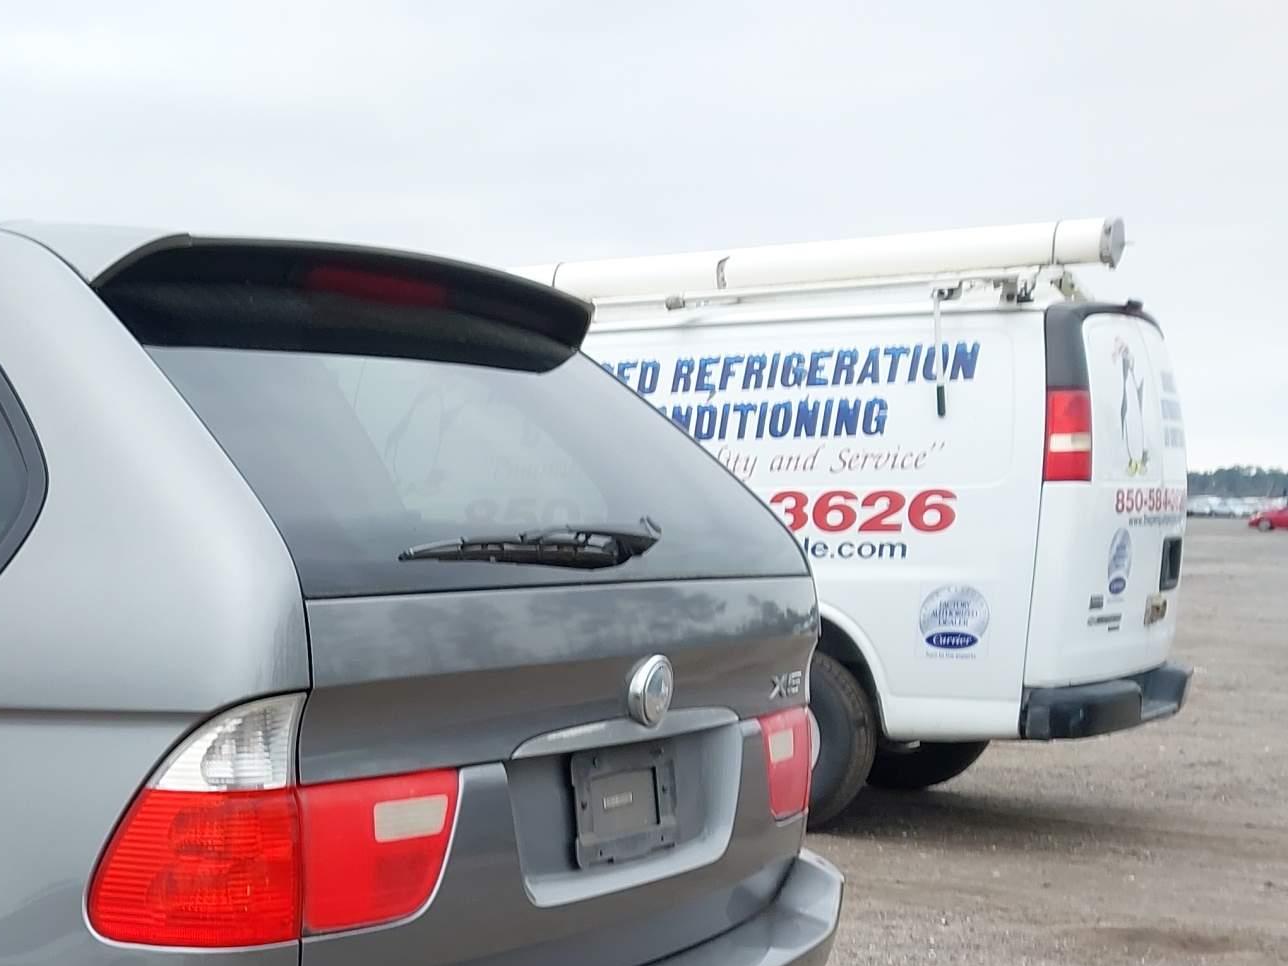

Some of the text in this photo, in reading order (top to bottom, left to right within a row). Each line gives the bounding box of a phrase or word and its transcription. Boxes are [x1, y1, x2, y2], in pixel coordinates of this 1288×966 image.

[671, 341, 981, 394] REFRIGERATION
[769, 445, 825, 473] and
[769, 488, 958, 533] 3626
[769, 670, 802, 700] X5
